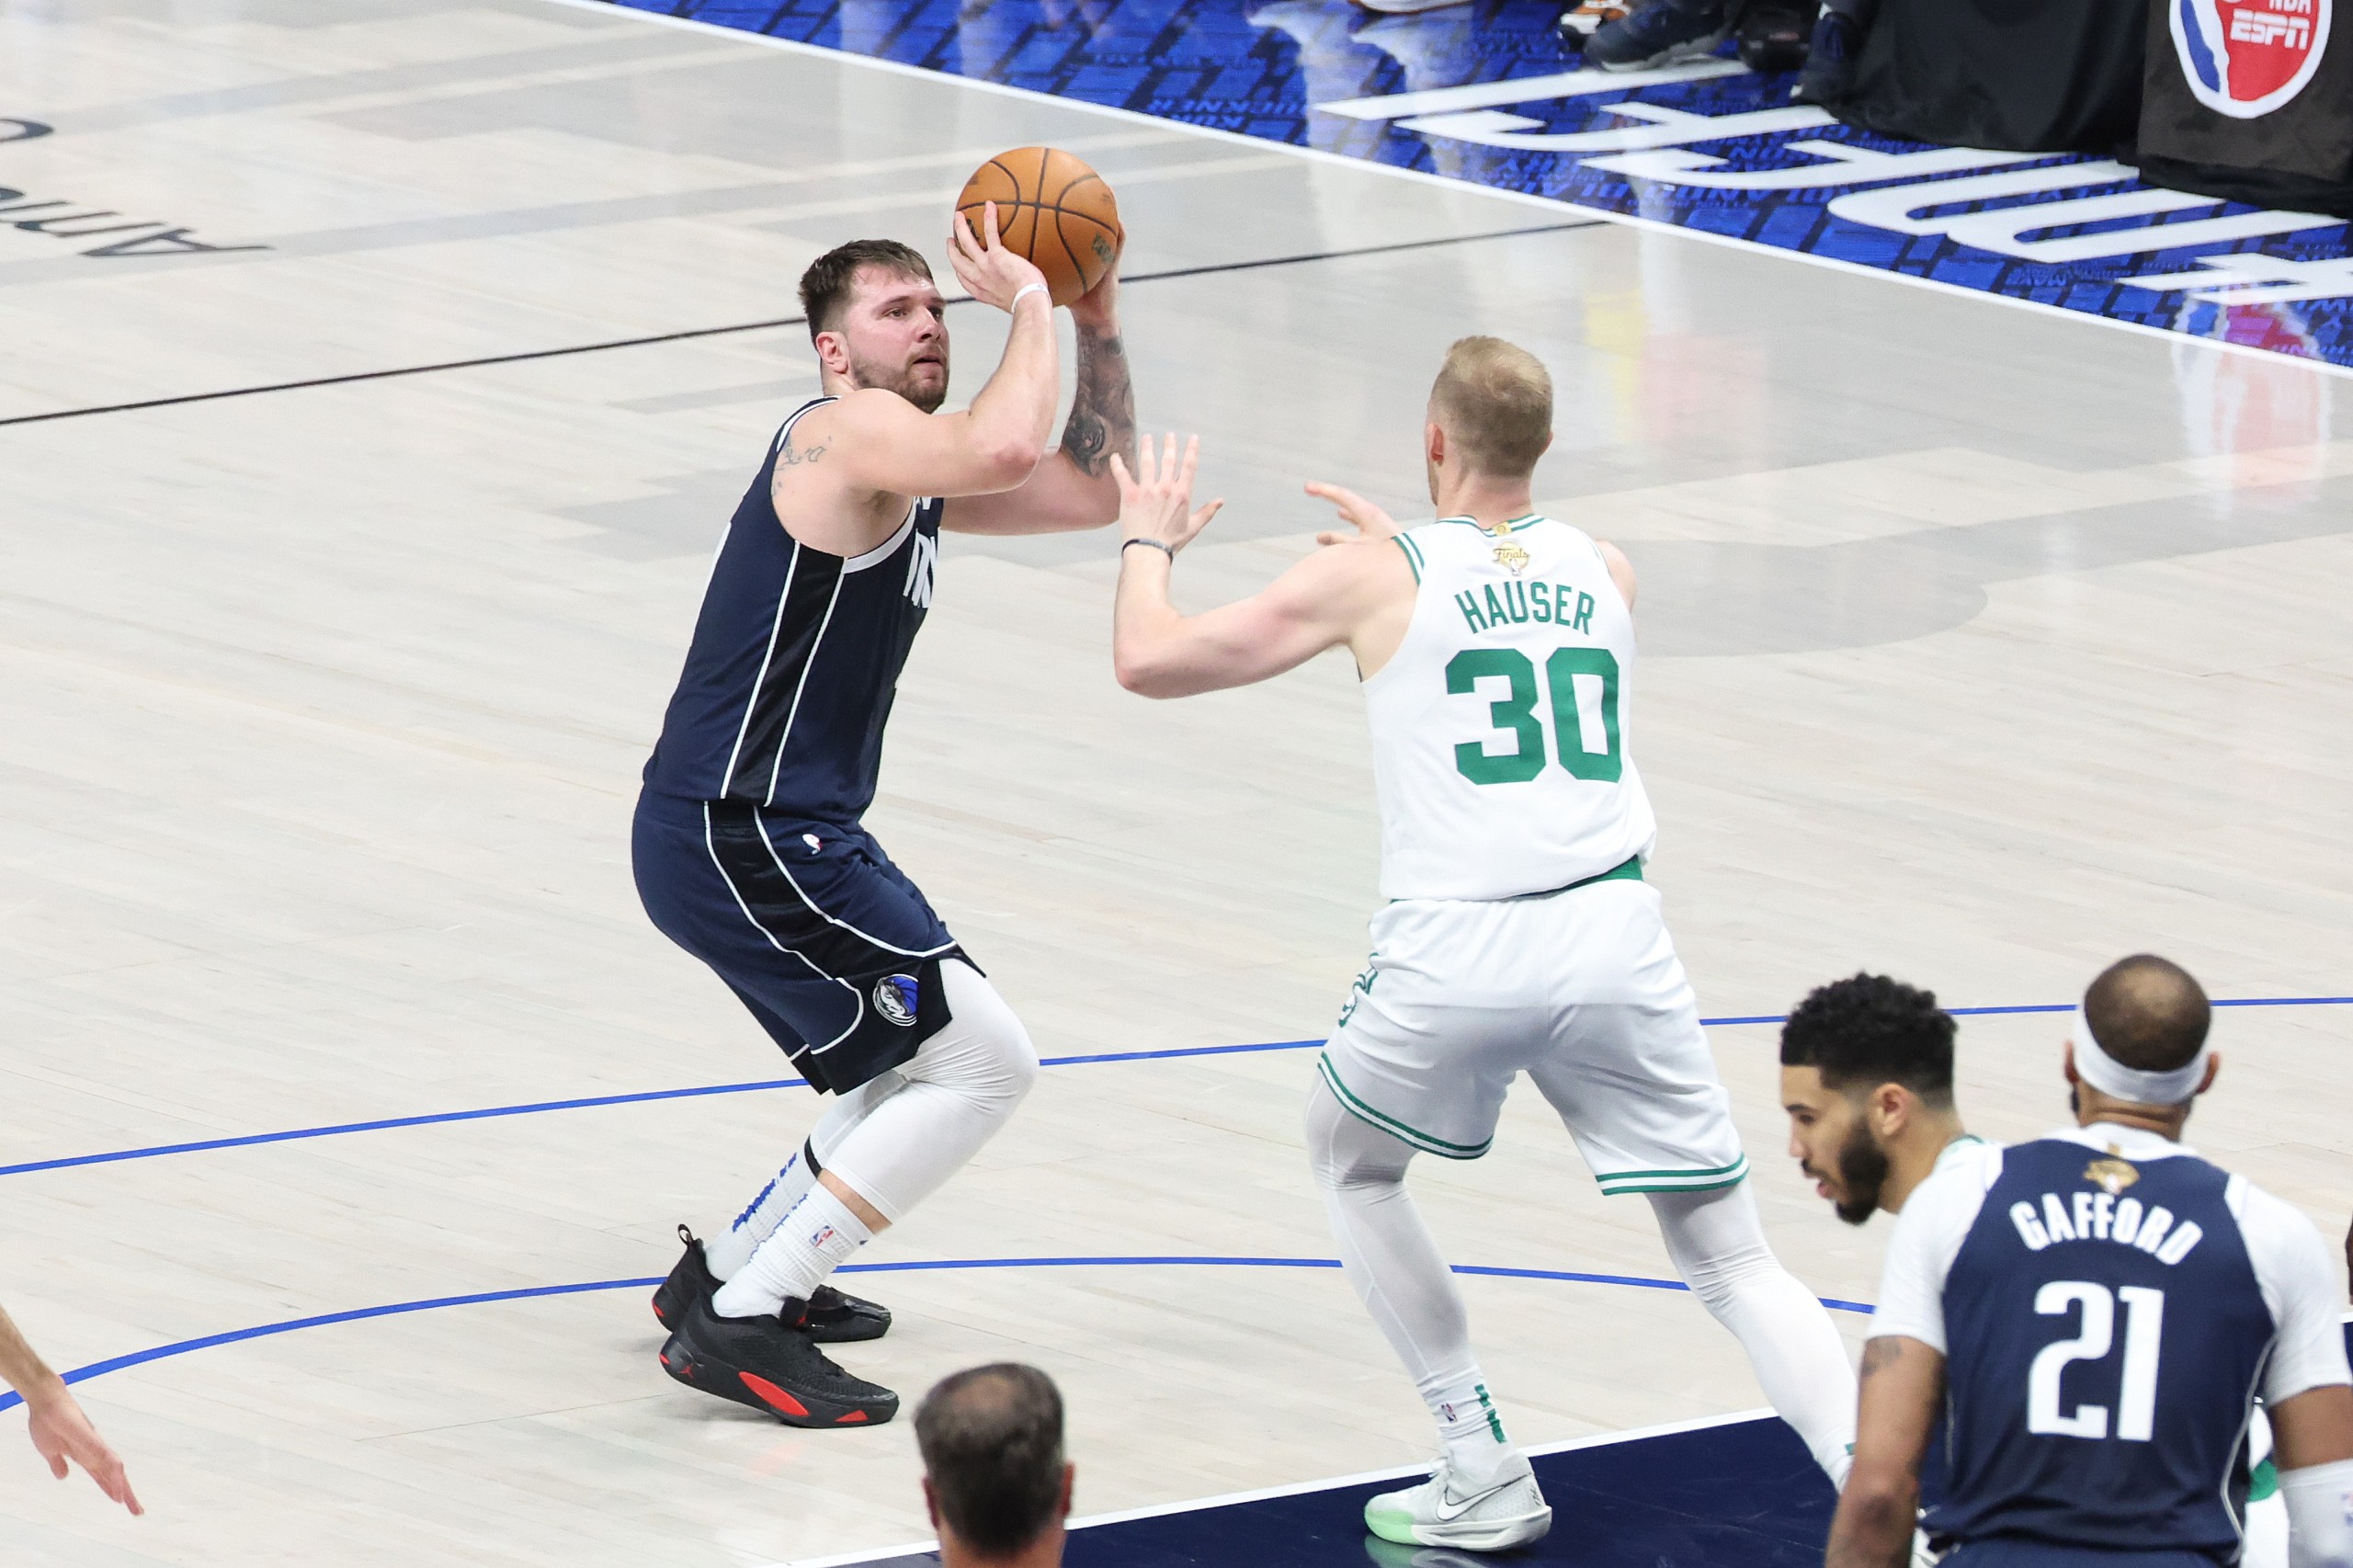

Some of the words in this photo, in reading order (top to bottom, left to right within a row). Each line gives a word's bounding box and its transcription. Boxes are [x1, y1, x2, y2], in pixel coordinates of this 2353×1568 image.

[2230, 8, 2310, 51] ESPN
[1453, 581, 1596, 636] HAUSER
[1445, 647, 1623, 786] 30
[2009, 1191, 2204, 1266] GAFFORD
[2027, 1280, 2165, 1442] 21
